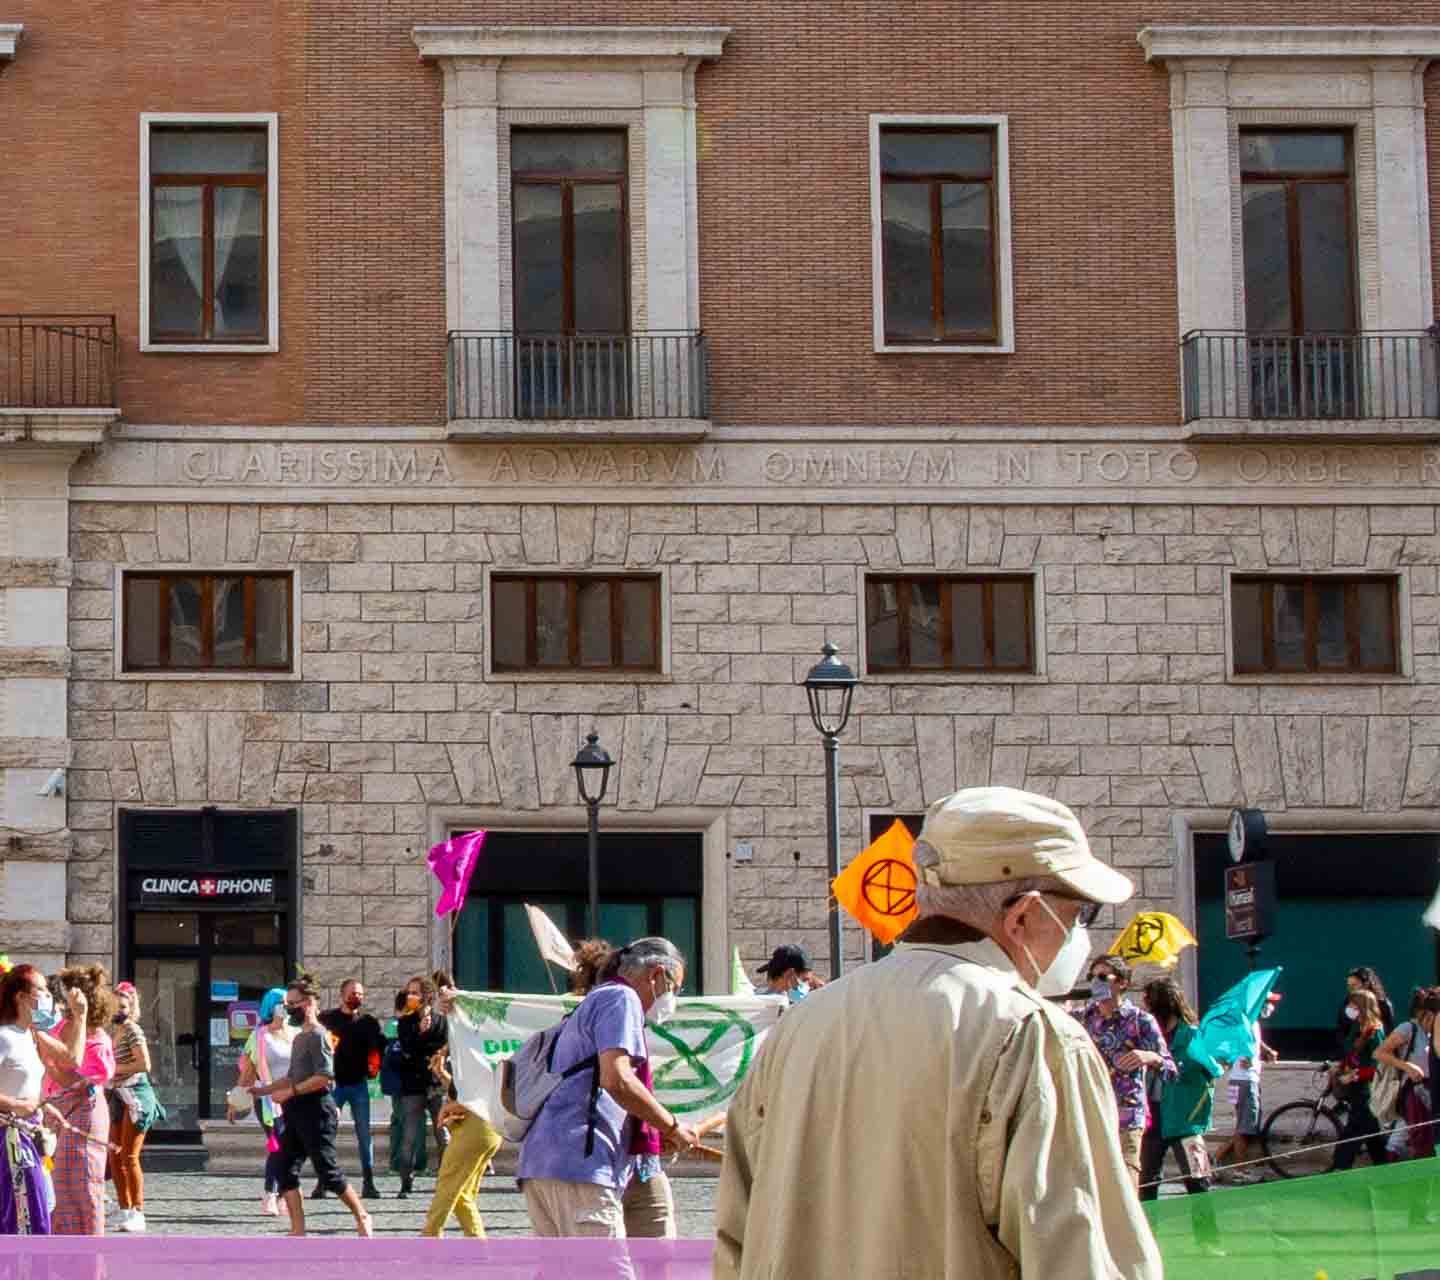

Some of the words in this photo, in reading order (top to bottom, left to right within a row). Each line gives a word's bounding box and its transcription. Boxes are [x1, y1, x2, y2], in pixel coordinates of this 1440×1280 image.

[183, 448, 456, 482] CLARISSIMA
[489, 448, 725, 482] AQVARVM
[993, 449, 1032, 483] IN
[1064, 449, 1200, 483] TOTO
[142, 877, 200, 894] CLINICA
[216, 877, 273, 895] IPHONE
